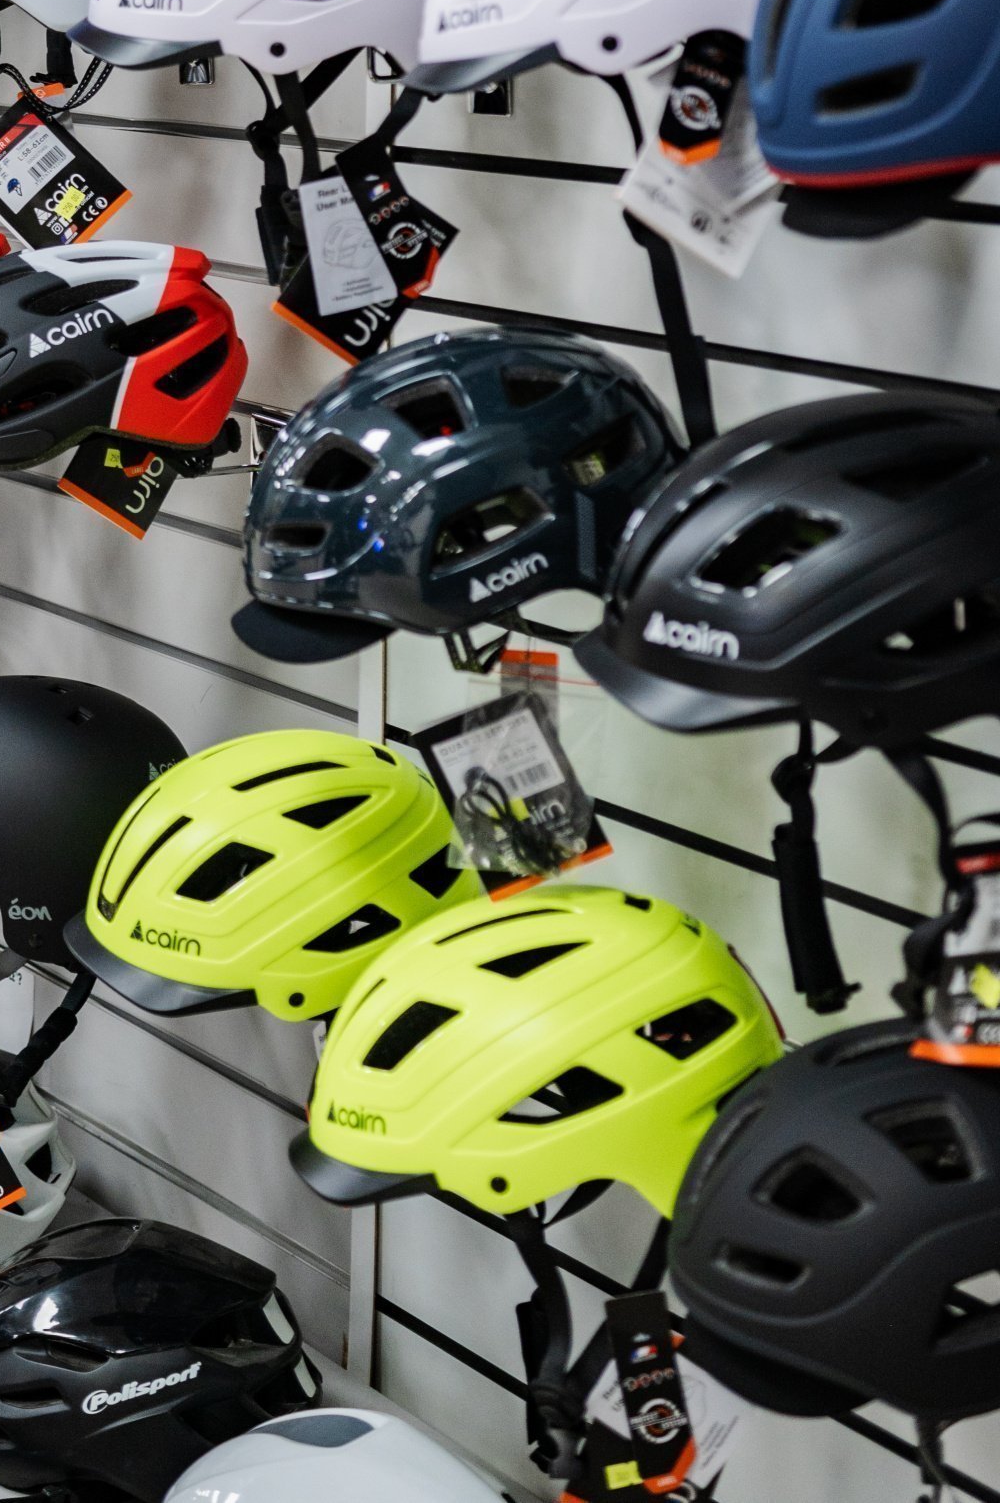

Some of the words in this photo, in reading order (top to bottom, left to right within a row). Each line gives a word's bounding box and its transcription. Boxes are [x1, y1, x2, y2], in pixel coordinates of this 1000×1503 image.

[450, 2, 503, 30] cairn
[45, 306, 115, 347] cairn
[125, 456, 165, 514] airn
[486, 550, 550, 596] cairn
[664, 619, 741, 662] cairn
[147, 926, 201, 957] cairn
[337, 1105, 387, 1137] cairn
[82, 1361, 202, 1415] Polisport
